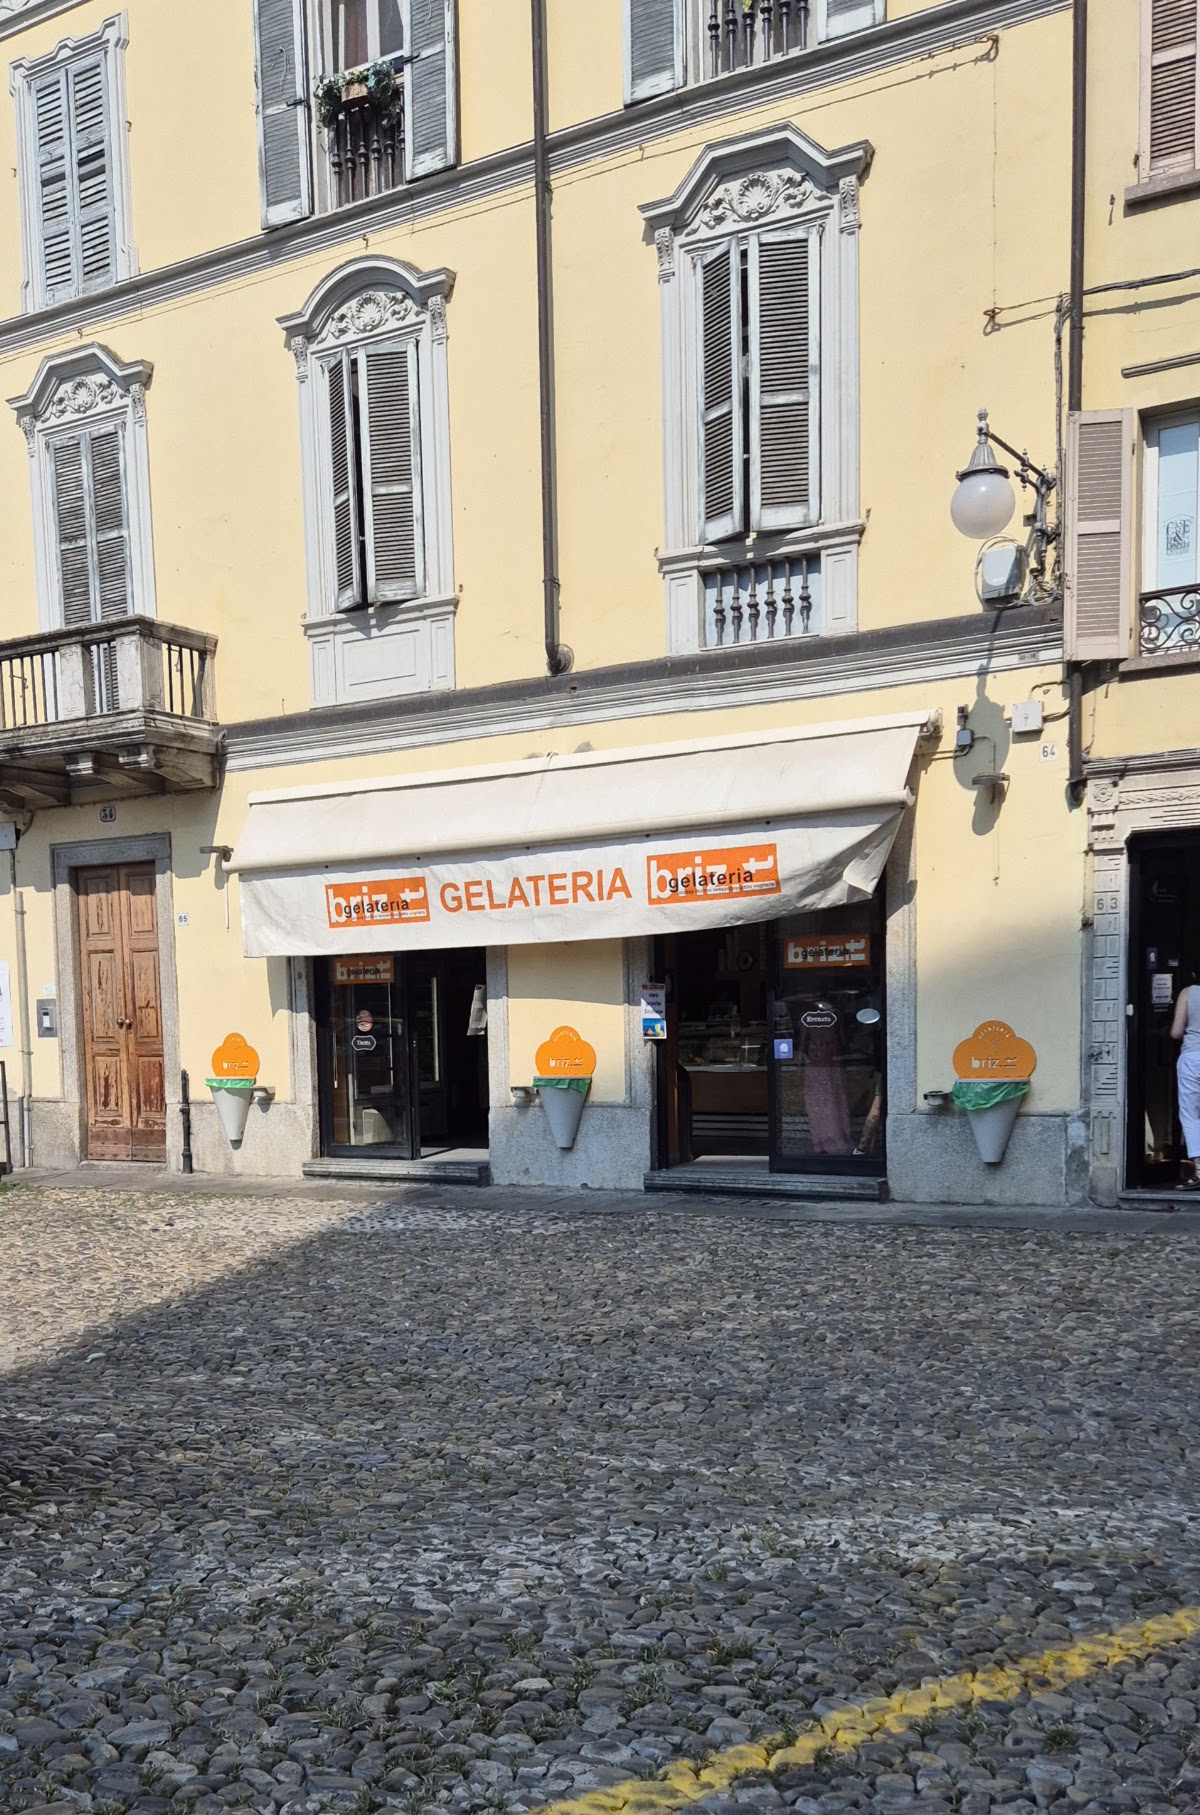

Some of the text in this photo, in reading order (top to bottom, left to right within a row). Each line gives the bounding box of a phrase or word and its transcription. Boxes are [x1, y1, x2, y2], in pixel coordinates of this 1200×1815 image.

[1042, 744, 1056, 758] 64
[668, 868, 754, 893] gelateria
[439, 867, 633, 913] GELATERIA
[343, 899, 410, 919] gelateria
[1096, 897, 1118, 910] 63
[178, 914, 188, 923] 65
